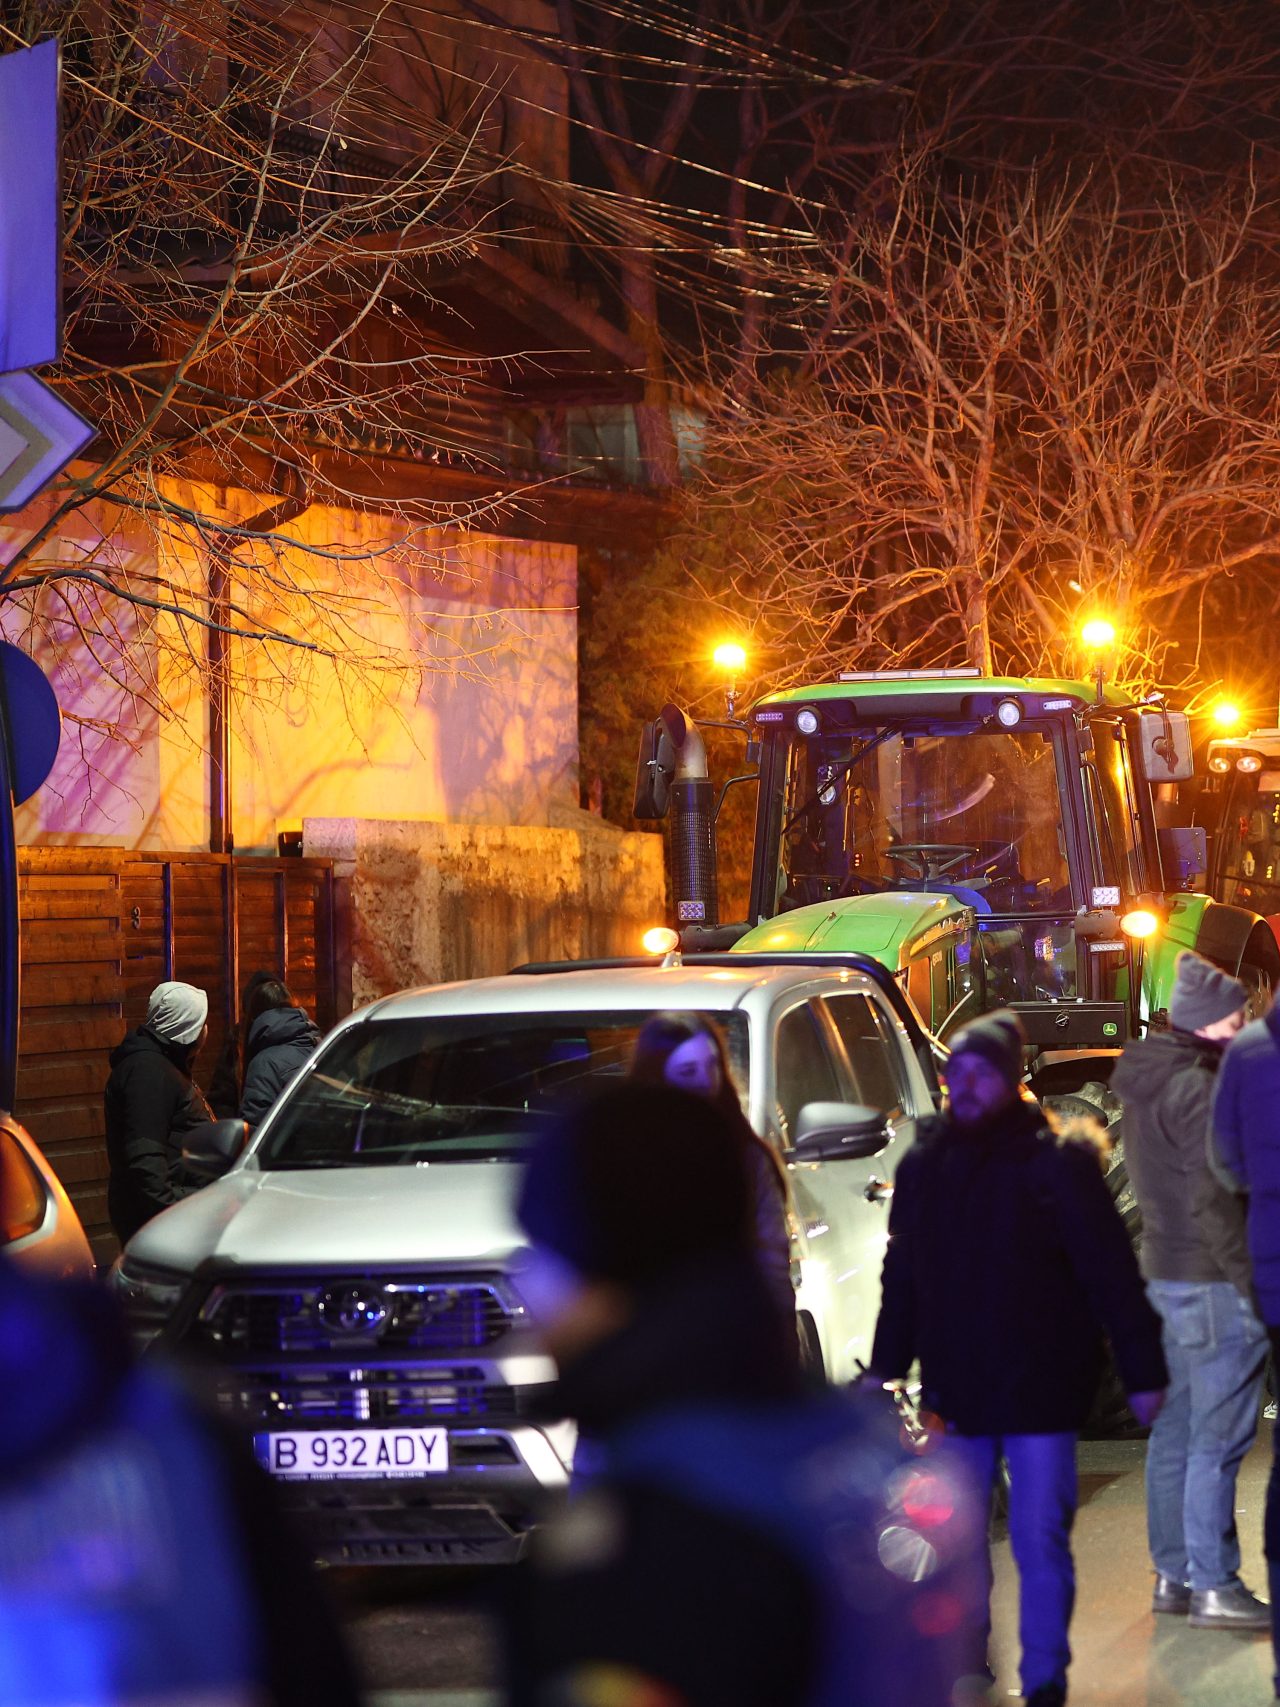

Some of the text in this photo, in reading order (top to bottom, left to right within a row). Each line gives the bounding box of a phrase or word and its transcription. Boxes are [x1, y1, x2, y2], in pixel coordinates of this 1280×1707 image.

[275, 1434, 437, 1469] B 932 ADY
